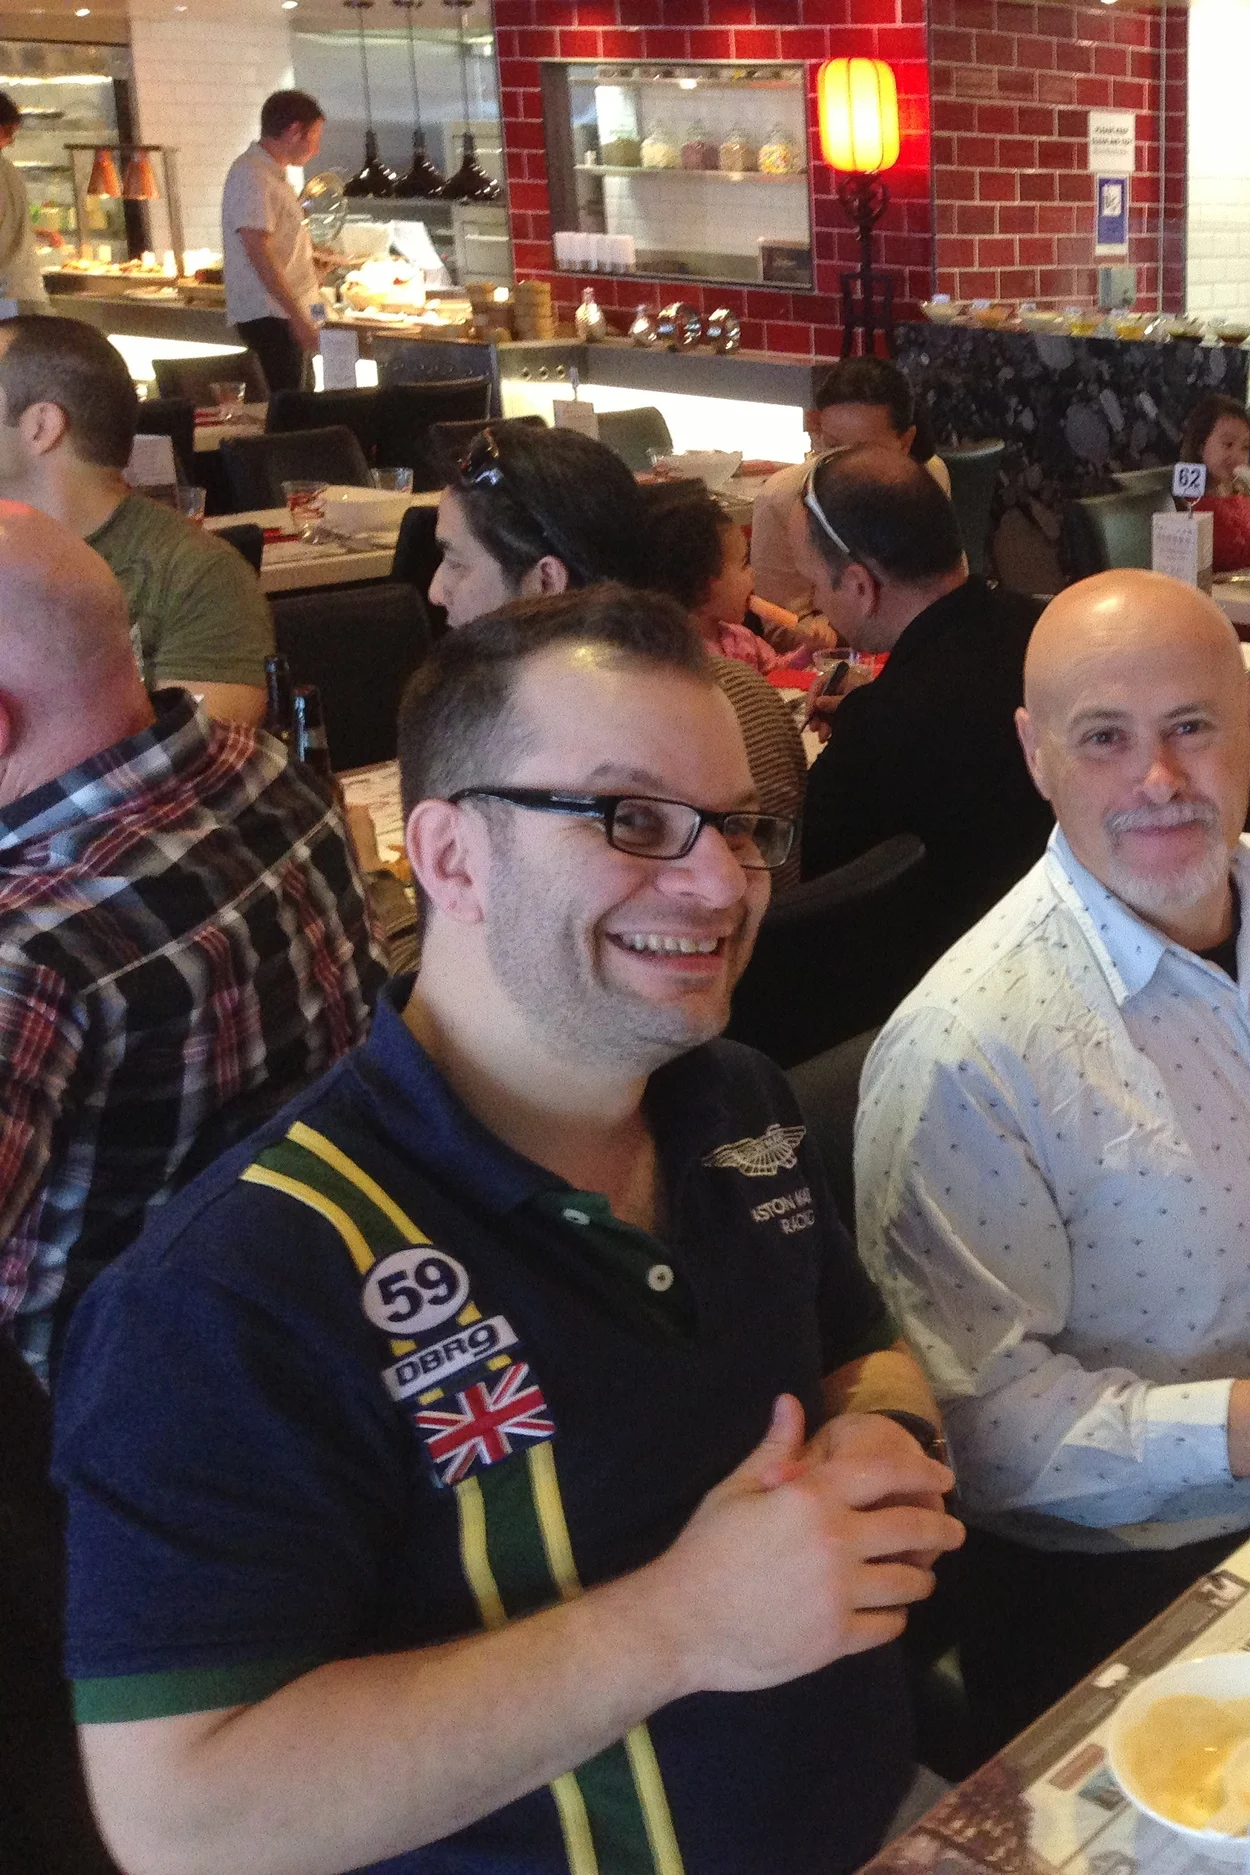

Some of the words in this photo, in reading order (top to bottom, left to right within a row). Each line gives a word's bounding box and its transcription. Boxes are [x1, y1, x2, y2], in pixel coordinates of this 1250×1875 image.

[1178, 466, 1202, 488] 62
[377, 1256, 461, 1323] 59
[395, 1323, 500, 1386] DBR9
